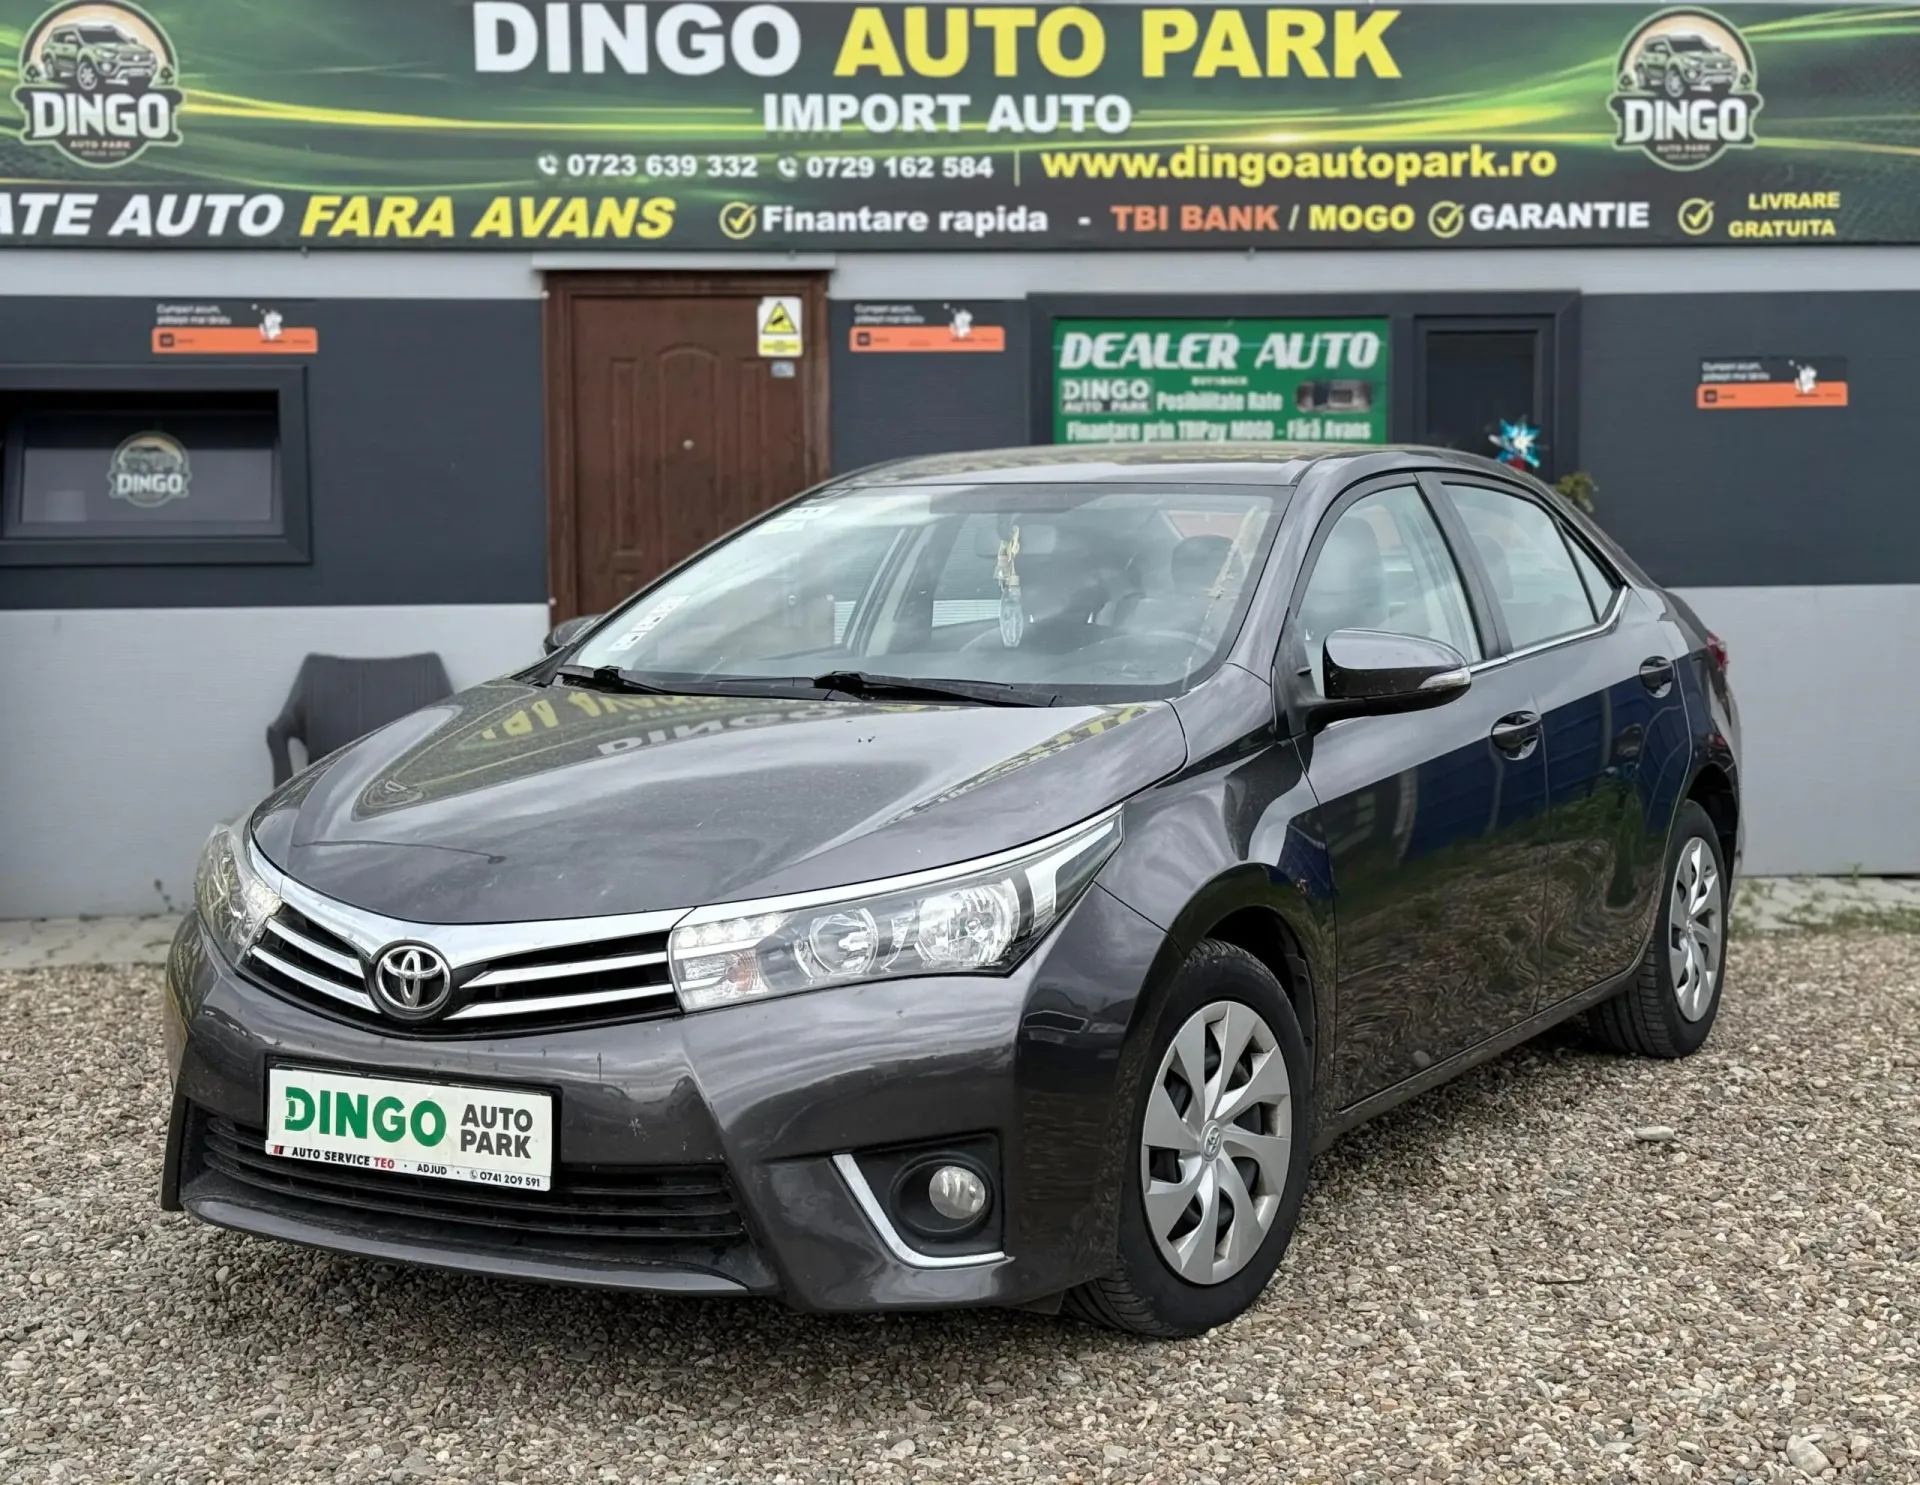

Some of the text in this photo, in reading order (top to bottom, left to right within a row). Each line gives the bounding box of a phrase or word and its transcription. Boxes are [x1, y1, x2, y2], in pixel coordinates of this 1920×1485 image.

[473, 2, 1402, 80] DINGO AUTO PARK
[31, 92, 169, 138] DINGO
[764, 94, 1132, 133] IMPORT AUTO
[1624, 98, 1747, 143] DINGO
[567, 154, 758, 177] 0723 639 332
[806, 156, 993, 178] 0729 162 584
[1041, 144, 1556, 187] www.dingoautopark.ro
[109, 194, 284, 236] AUTO
[1749, 192, 1840, 210] LIVRARE
[301, 196, 675, 238] FARA AVANS
[763, 205, 1048, 238] Finantare rapida
[1111, 206, 1168, 230] TBI
[1180, 206, 1278, 230] BANK
[1308, 205, 1415, 231] MOGO
[1469, 202, 1649, 230] GARANTIE
[1728, 219, 1836, 238] GRATUITA
[1059, 332, 1380, 370] DEALER AUTO
[1064, 379, 1150, 400] DINGO
[117, 474, 183, 494] DINGO
[285, 1086, 447, 1147] DINGO
[461, 1104, 534, 1133] AUTO
[291, 1146, 395, 1169] AUTO SERVICE TEO
[461, 1130, 532, 1159] PARK
[417, 1164, 448, 1175] ADJUD
[480, 1171, 541, 1187] 0741 209 591
